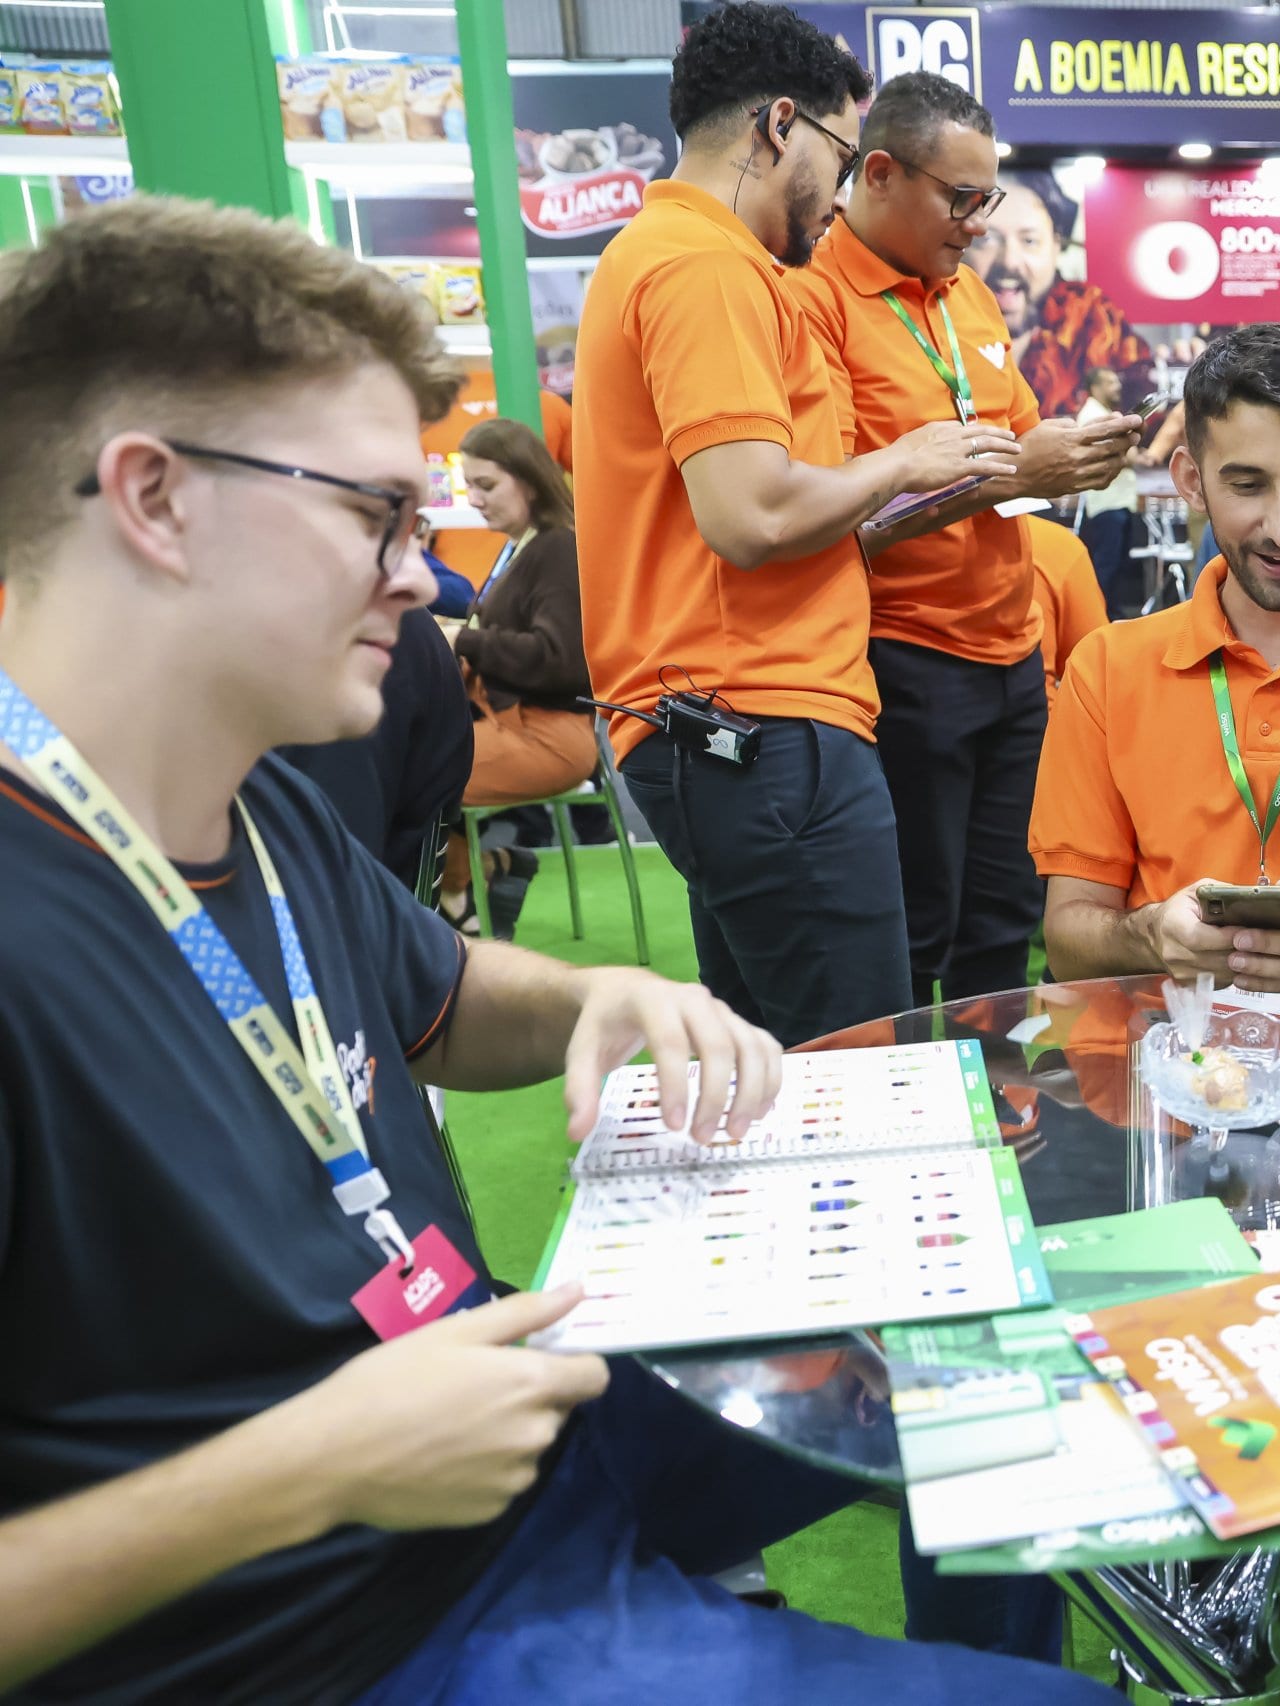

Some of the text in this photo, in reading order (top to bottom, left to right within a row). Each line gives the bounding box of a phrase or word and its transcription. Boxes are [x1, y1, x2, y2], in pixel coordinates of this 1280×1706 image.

[1014, 38, 1043, 93] A
[1050, 39, 1190, 96] BOEMIA
[538, 180, 642, 225] ALIANÇA
